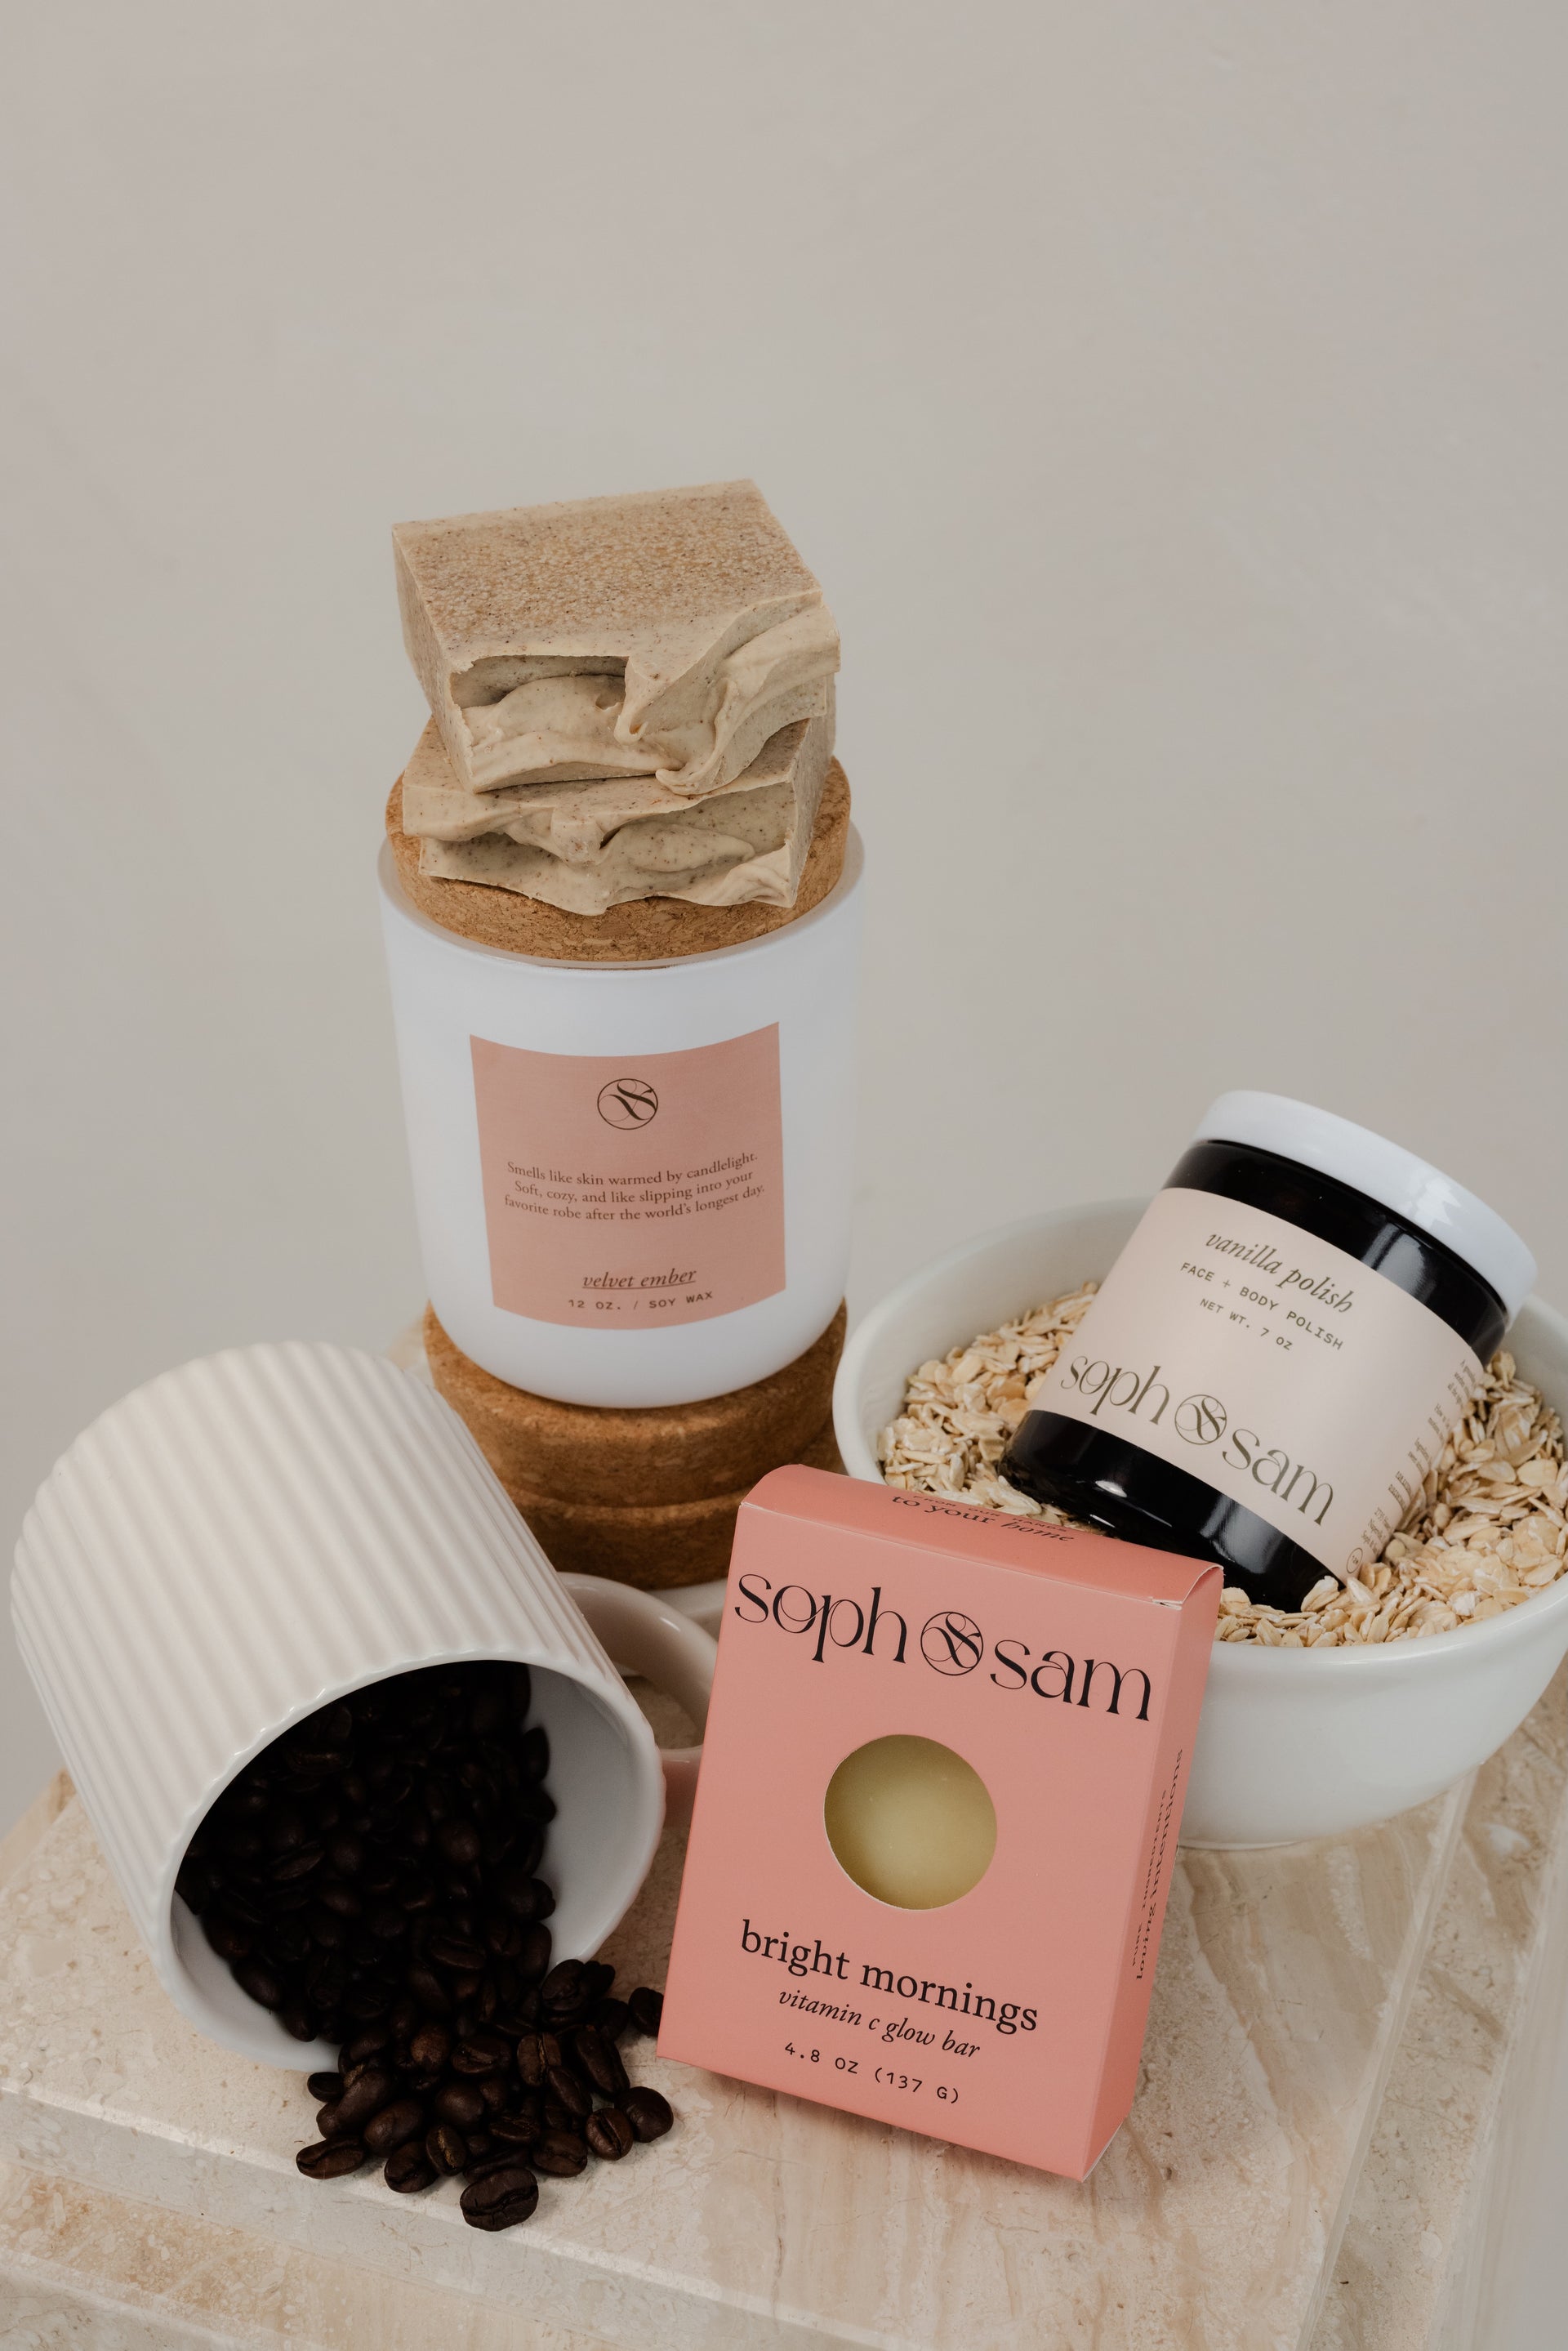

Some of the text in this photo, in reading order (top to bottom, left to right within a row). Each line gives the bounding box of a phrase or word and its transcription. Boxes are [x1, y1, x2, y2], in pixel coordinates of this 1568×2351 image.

[507, 1153, 758, 1185] Smells like skin warmed by candlelight.
[514, 1171, 753, 1204] Soft, cozy, and like slipping into your
[505, 1194, 549, 1215] favorite
[553, 1207, 581, 1219] robe
[586, 1208, 615, 1220] after
[620, 1208, 641, 1220] the
[695, 1193, 739, 1212] longest
[742, 1184, 765, 1199] day.
[568, 1299, 585, 1309] 12
[595, 1301, 621, 1310] OZ.
[648, 1297, 676, 1309] SOY
[686, 1291, 713, 1304] WAX
[582, 1268, 697, 1288] velvet ember
[1205, 1234, 1354, 1313] vanilla polish
[1180, 1262, 1214, 1282] FACE
[1240, 1287, 1279, 1311] BODY
[1286, 1310, 1343, 1349] POLISH
[1200, 1298, 1294, 1350] NET WT. 7 OZ
[1061, 1355, 1170, 1425] soph
[1223, 1428, 1334, 1526] sam
[892, 1496, 1074, 1541] to your home
[735, 1573, 906, 1663] soph
[990, 1639, 1152, 1722] sam
[1136, 1748, 1183, 1979] loving intentions
[741, 1919, 1038, 2035] bright mornings
[779, 1989, 981, 2059] vitamin c glow bar
[785, 2042, 960, 2104] 4.8 OZ (137 G)
